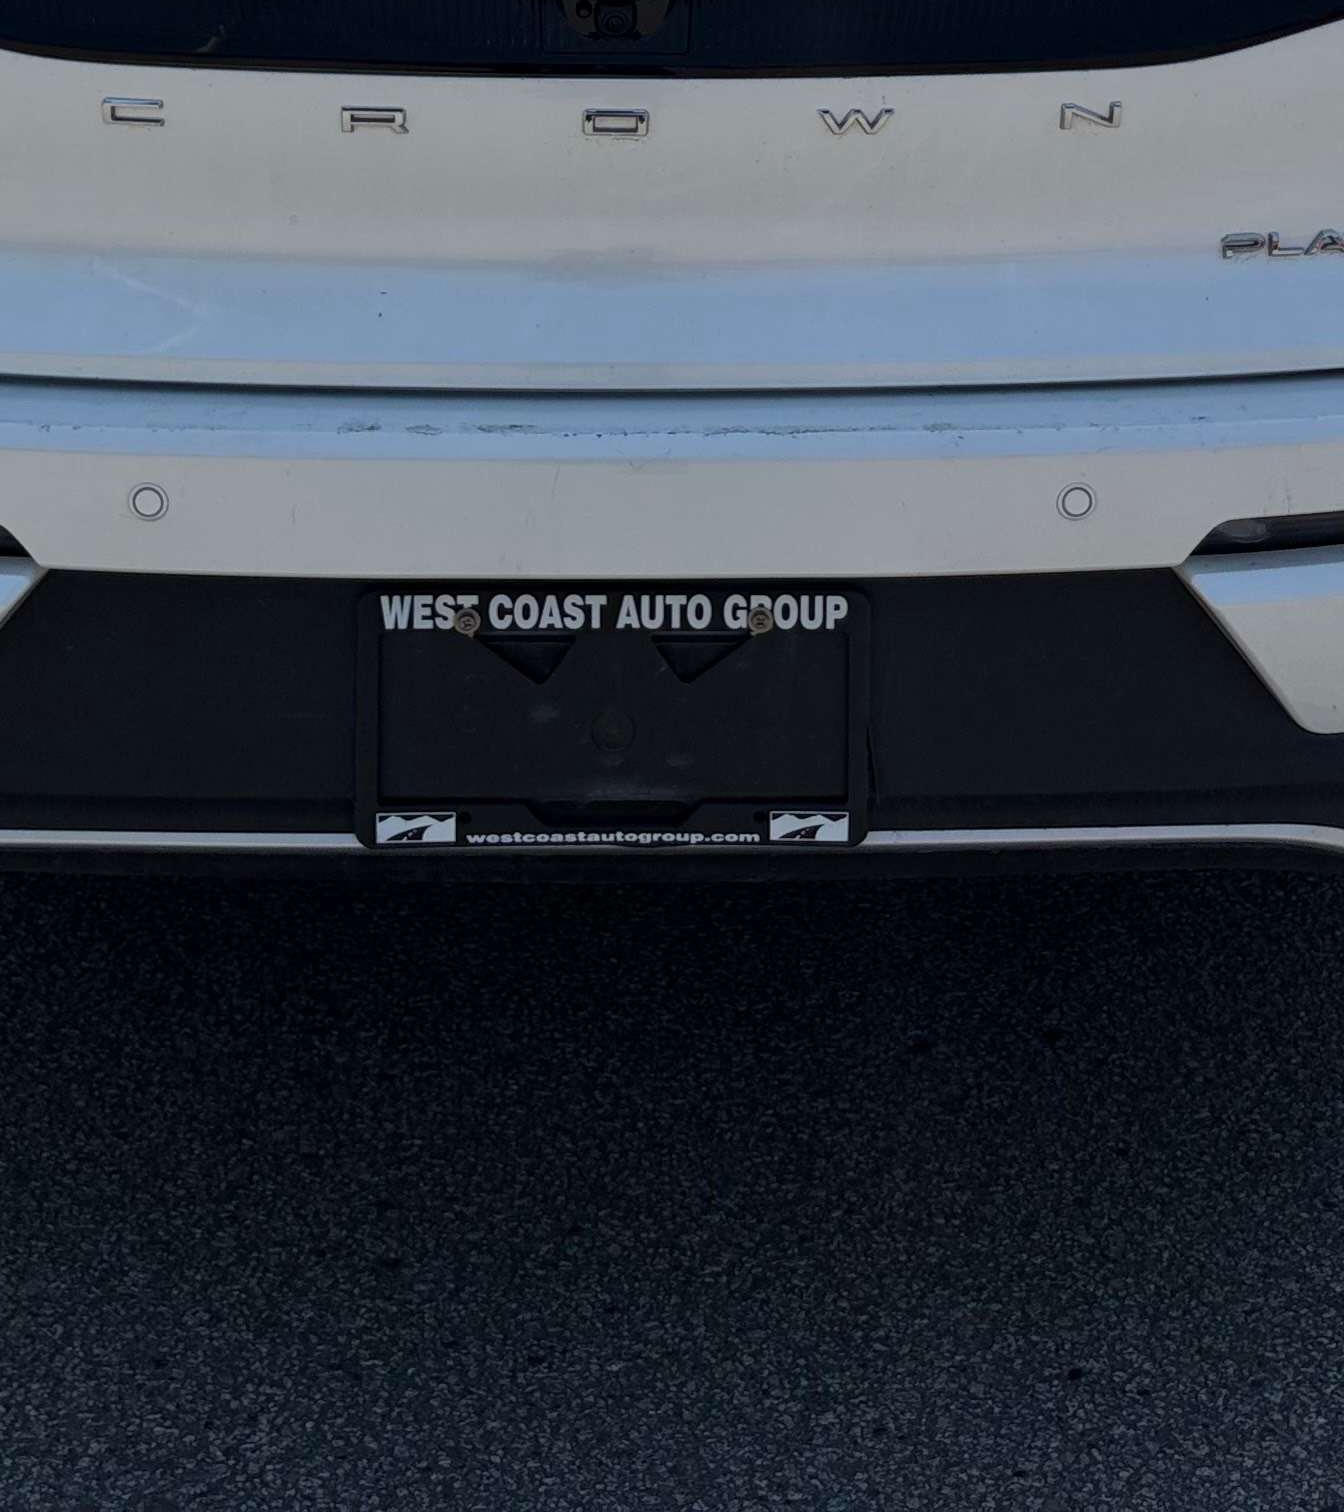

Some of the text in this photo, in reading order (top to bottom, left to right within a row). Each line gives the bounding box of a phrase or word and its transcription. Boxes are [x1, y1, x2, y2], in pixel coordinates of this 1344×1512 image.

[488, 594, 607, 630] COAST
[616, 594, 712, 630] AUTO
[466, 830, 761, 844] westcoastautogroup.com
